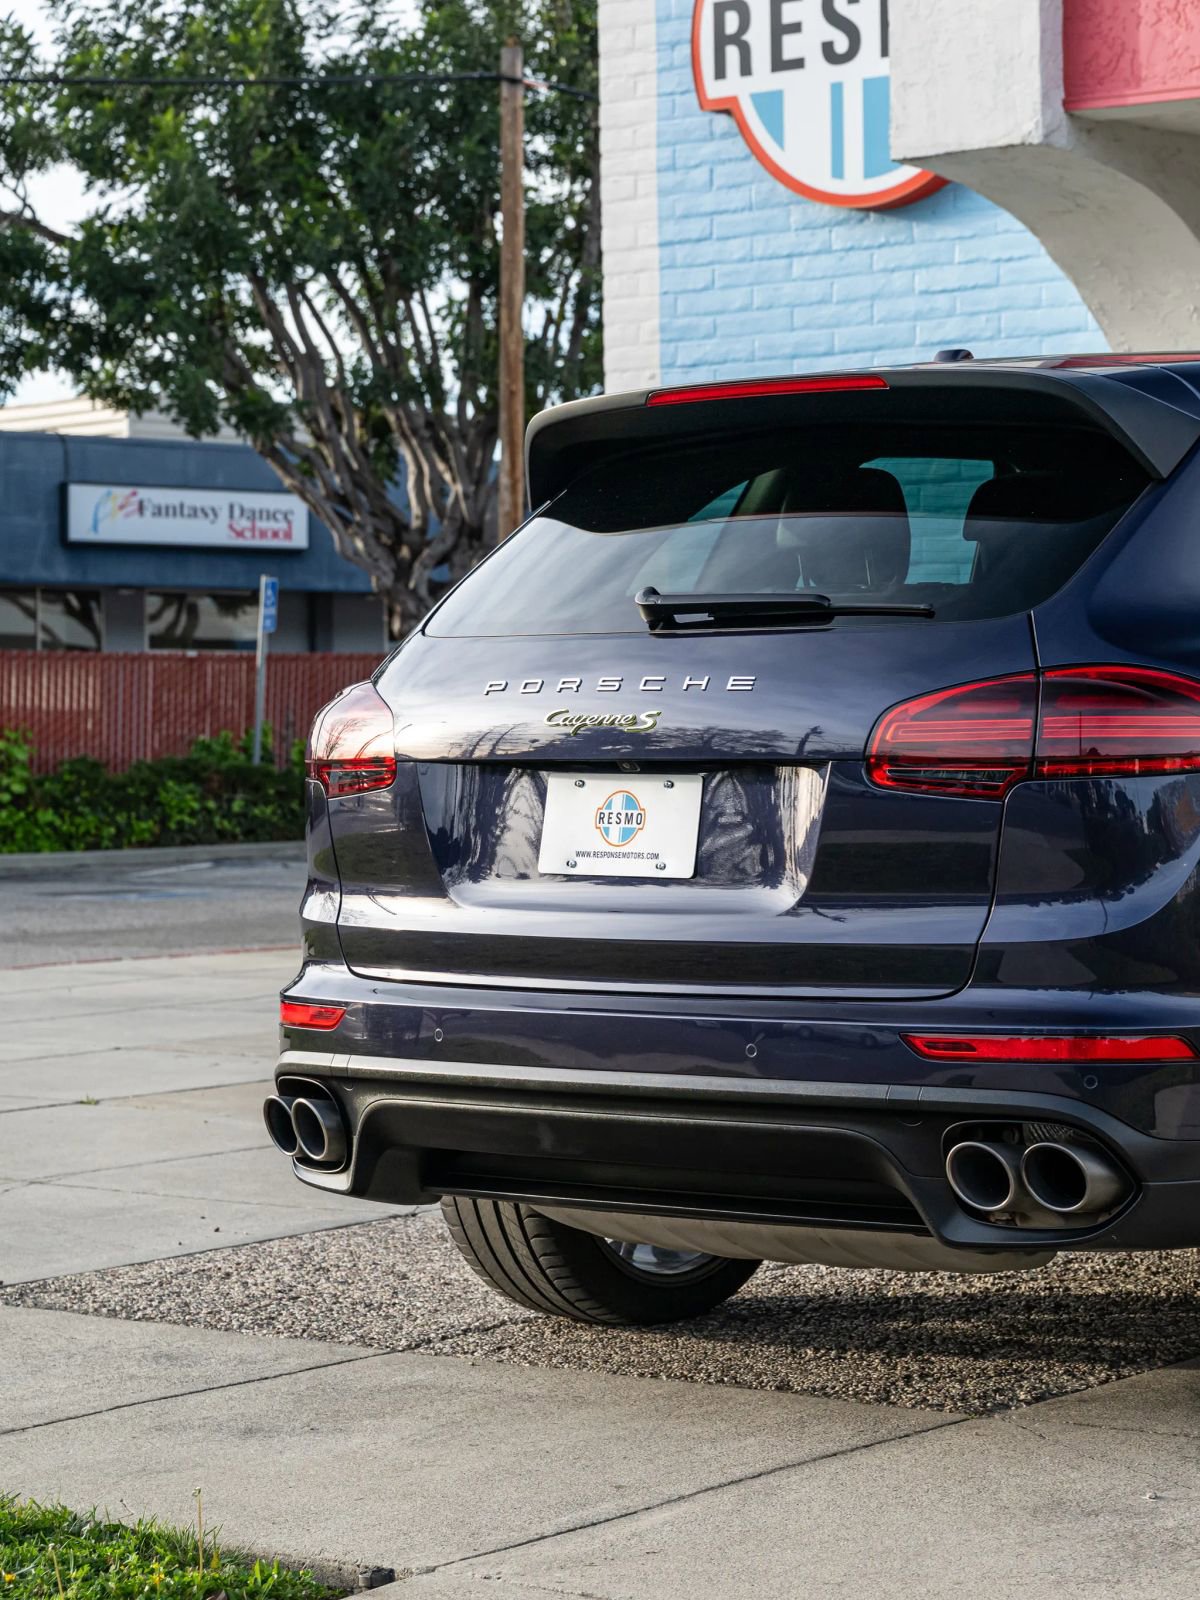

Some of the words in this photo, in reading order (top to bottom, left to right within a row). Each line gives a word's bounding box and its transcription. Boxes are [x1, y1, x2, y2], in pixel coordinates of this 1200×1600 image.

[713, 0, 890, 80] RES
[138, 498, 222, 525] Fantasy
[228, 502, 295, 523] Dance
[228, 518, 293, 543] School
[483, 676, 756, 696] PORSCHE
[544, 708, 637, 736] Cayenne
[624, 710, 662, 732] S
[598, 811, 643, 826] RESMO
[575, 850, 660, 860] WWW.RESPONSEMOTORS.COM
